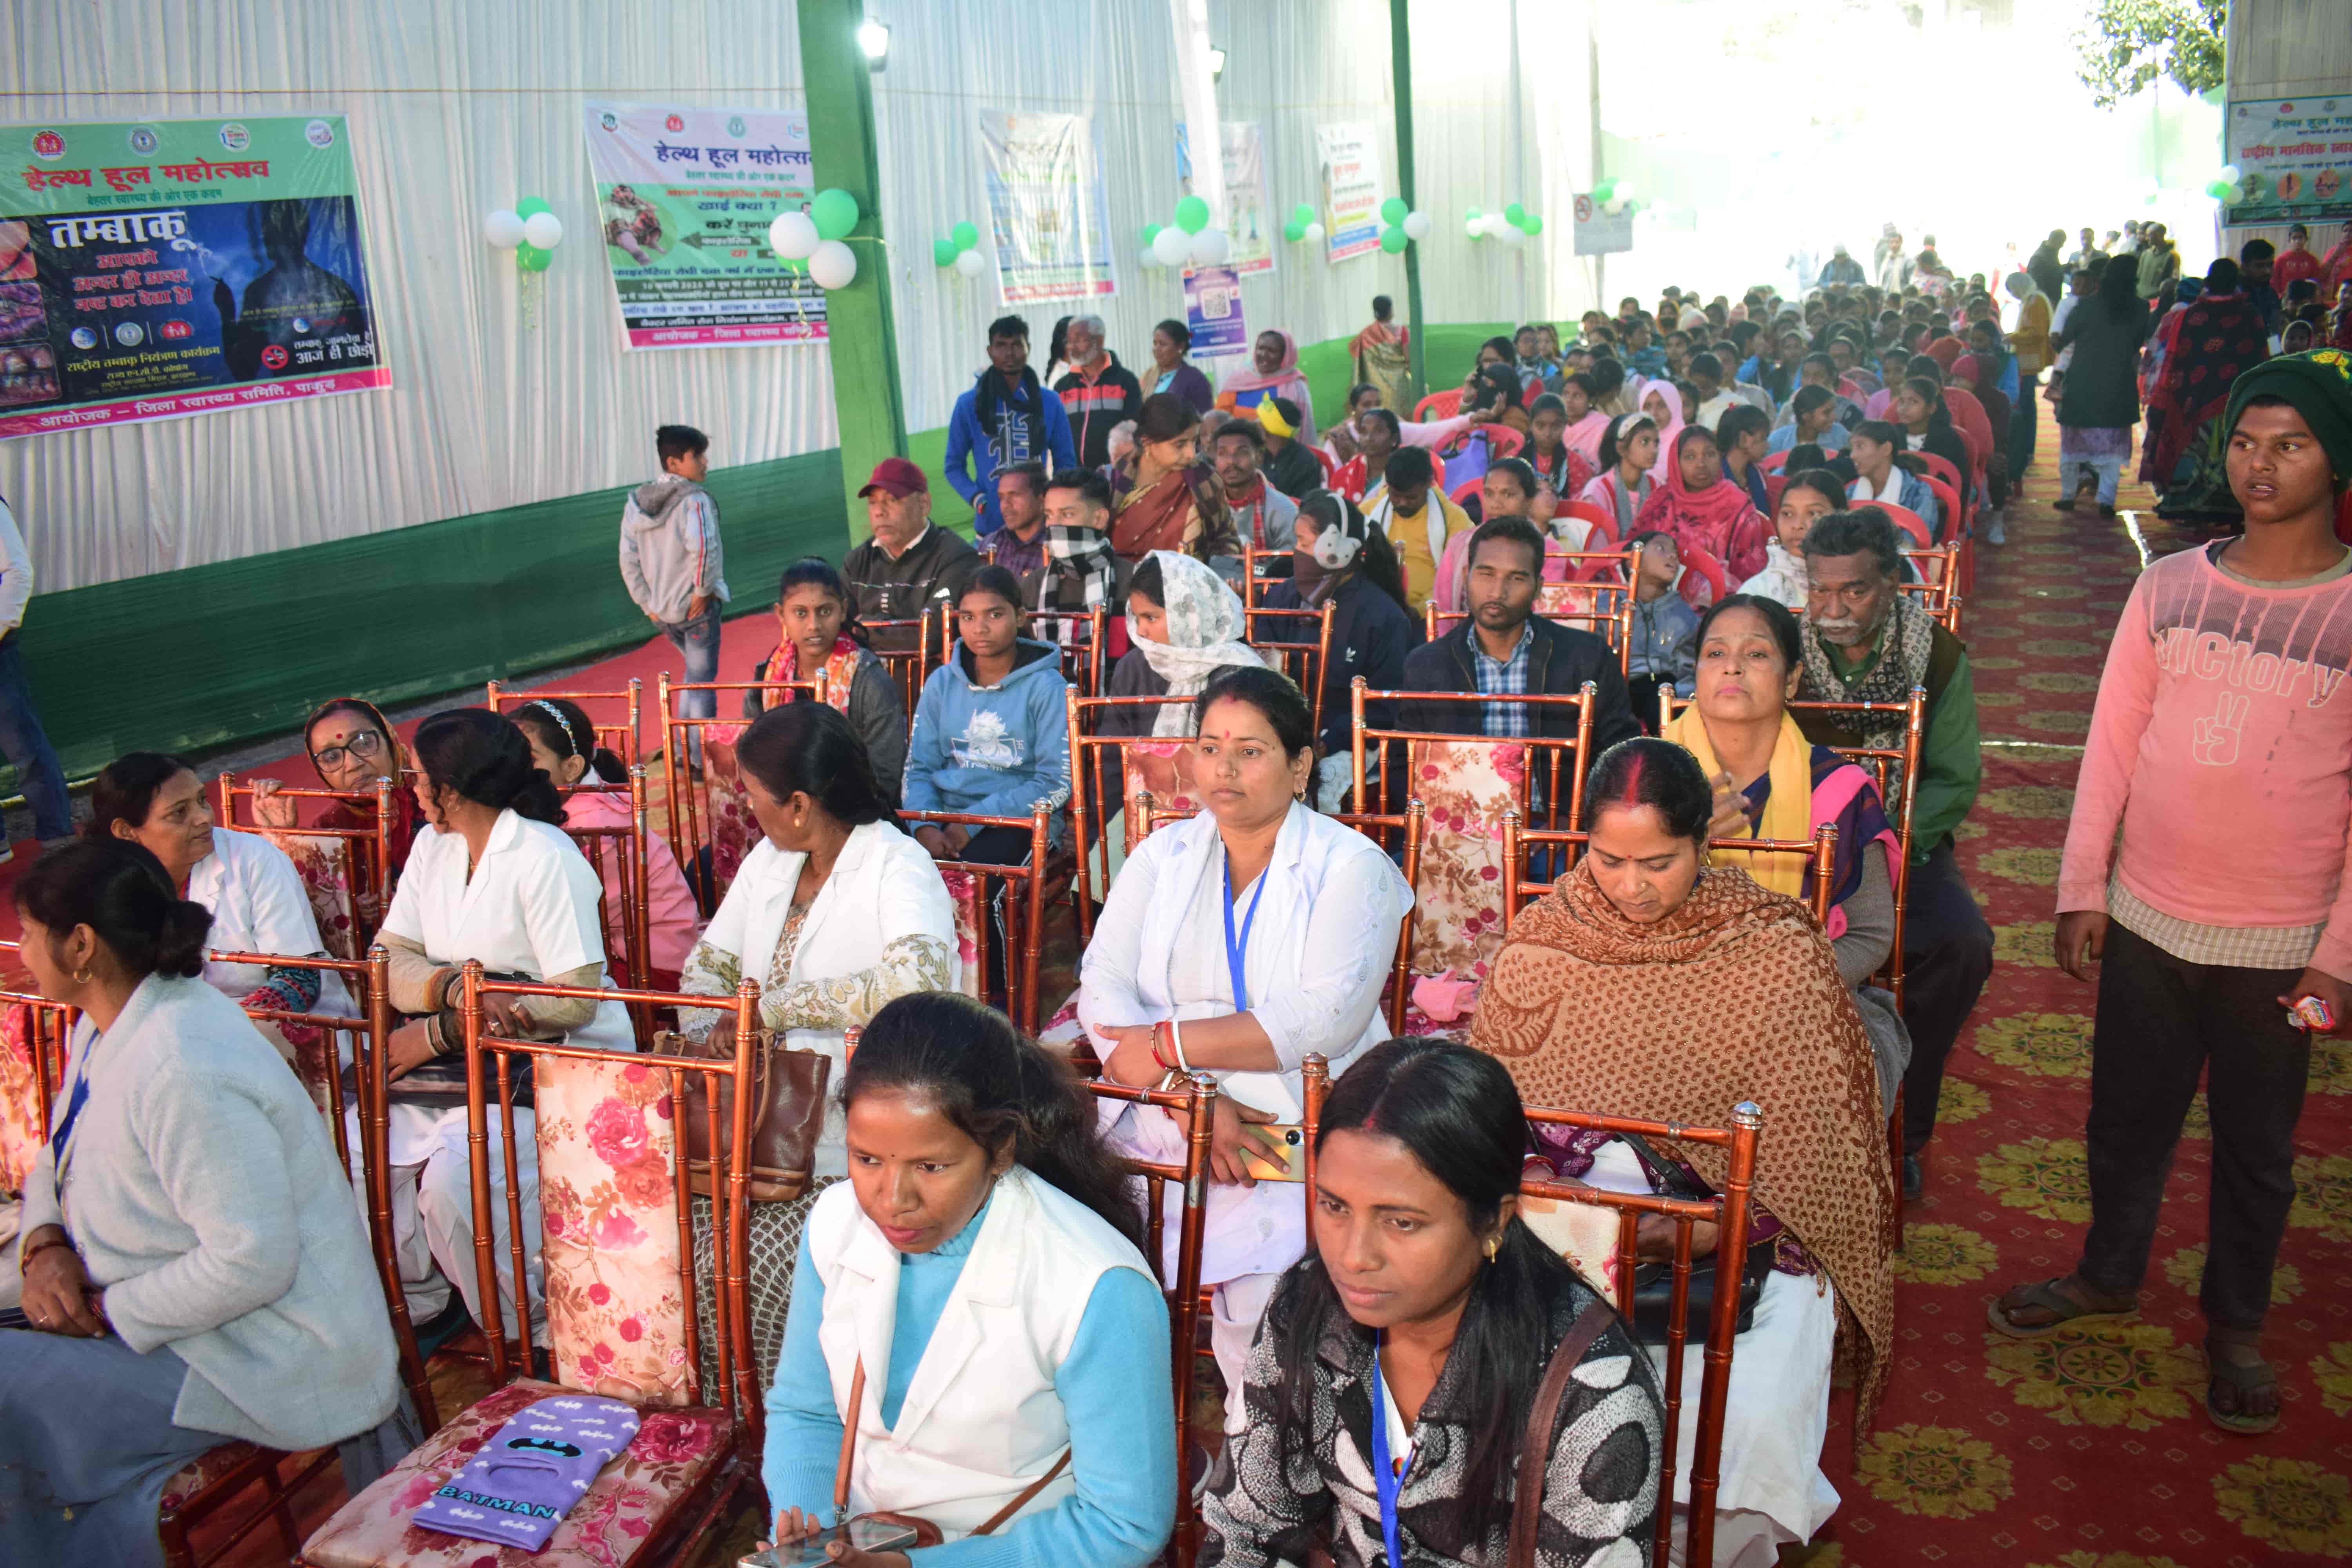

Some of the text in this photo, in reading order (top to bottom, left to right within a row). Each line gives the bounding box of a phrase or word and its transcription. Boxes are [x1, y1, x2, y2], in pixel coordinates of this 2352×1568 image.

[653, 139, 812, 169] हेल्थ हूल महोत्स
[21, 165, 92, 192] हेल्थ
[100, 166, 151, 192] हूल
[86, 188, 222, 206] बेहतर स्वास्थ्य की ओर एक कदम
[45, 211, 197, 251] तम्बाकू
[737, 220, 772, 234] चुना
[96, 248, 158, 269] आपको
[73, 268, 188, 291] अन्दर ही अन्दर
[74, 296, 107, 312] नष्ट
[109, 294, 136, 308] कर
[138, 289, 172, 306] देता
[296, 350, 324, 364] आज
[329, 344, 342, 359] ही
[41, 408, 111, 427] आयोजक
[134, 400, 176, 415] जिला
[180, 392, 235, 408] स्वास्थ्य
[437, 1486, 557, 1519] BATMAN
